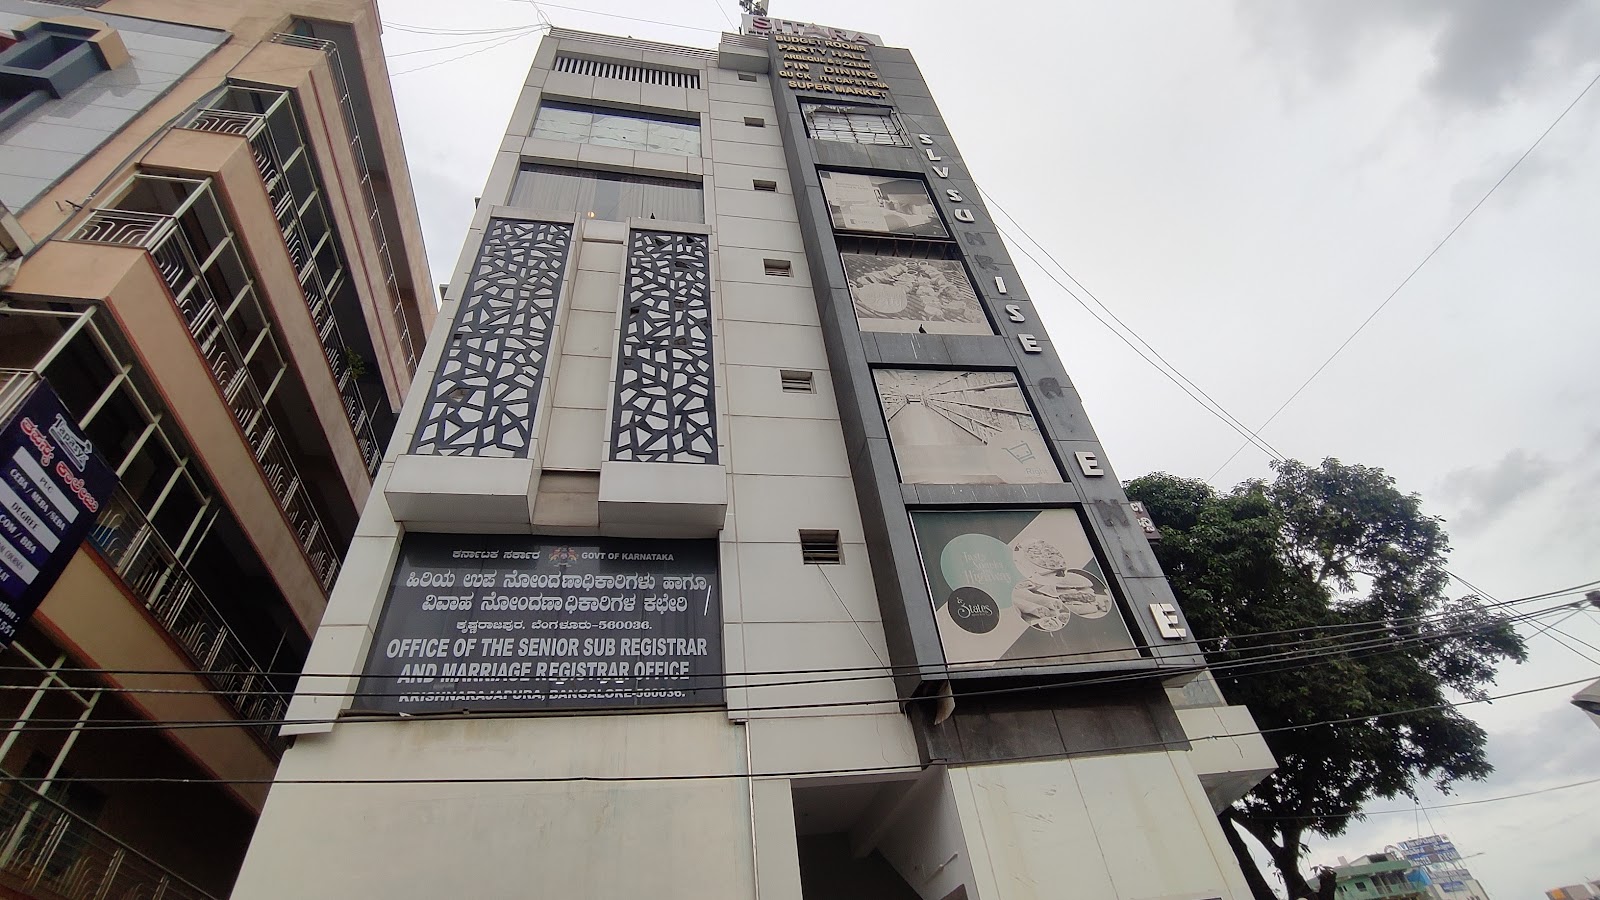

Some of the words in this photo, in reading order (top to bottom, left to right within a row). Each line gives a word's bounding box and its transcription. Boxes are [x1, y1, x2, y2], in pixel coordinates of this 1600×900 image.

[753, 15, 876, 46] SITARA
[775, 35, 822, 45] BUDGET
[825, 40, 866, 52] ROOMS
[778, 43, 827, 55] PARTY
[832, 49, 870, 61] HALL
[824, 66, 878, 80] DINING
[788, 80, 833, 93] SUPER
[834, 85, 886, 98] MARKET
[918, 133, 949, 179] SLV
[10, 468, 29, 490] CEBA
[40, 477, 52, 493] PUC
[11, 502, 39, 531] DEGREE
[20, 536, 37, 554] BBA
[452, 549, 499, 559] ಕರ್ನಾಟಕ
[503, 550, 540, 560] ಸರ್ಕಾರ
[4, 550, 24, 571] COURSES
[581, 551, 606, 560] GOVT
[608, 552, 620, 560] OF
[621, 552, 675, 561] KARNATAKA
[406, 569, 455, 588] ಹಿರಿಯ
[463, 569, 497, 588] ಉಪ
[503, 569, 656, 591] ನೋಂದಣಾಧಿಕಾರಿಗಳು
[663, 572, 707, 590] ಹಾಗೂ
[422, 591, 474, 611] ವಿವಾಹ
[644, 593, 688, 614] ಕಛೇರಿ
[386, 638, 450, 658] OFFICE
[453, 638, 477, 657] OF
[481, 638, 514, 657] THE
[518, 638, 579, 657] SENIOR
[583, 638, 616, 657] SUB
[620, 638, 707, 657] REGISTRAR
[397, 663, 437, 683] AND
[440, 662, 531, 683] MARRIAGE
[535, 661, 629, 682] REGISTRAR
[634, 661, 689, 680] OFFICE
